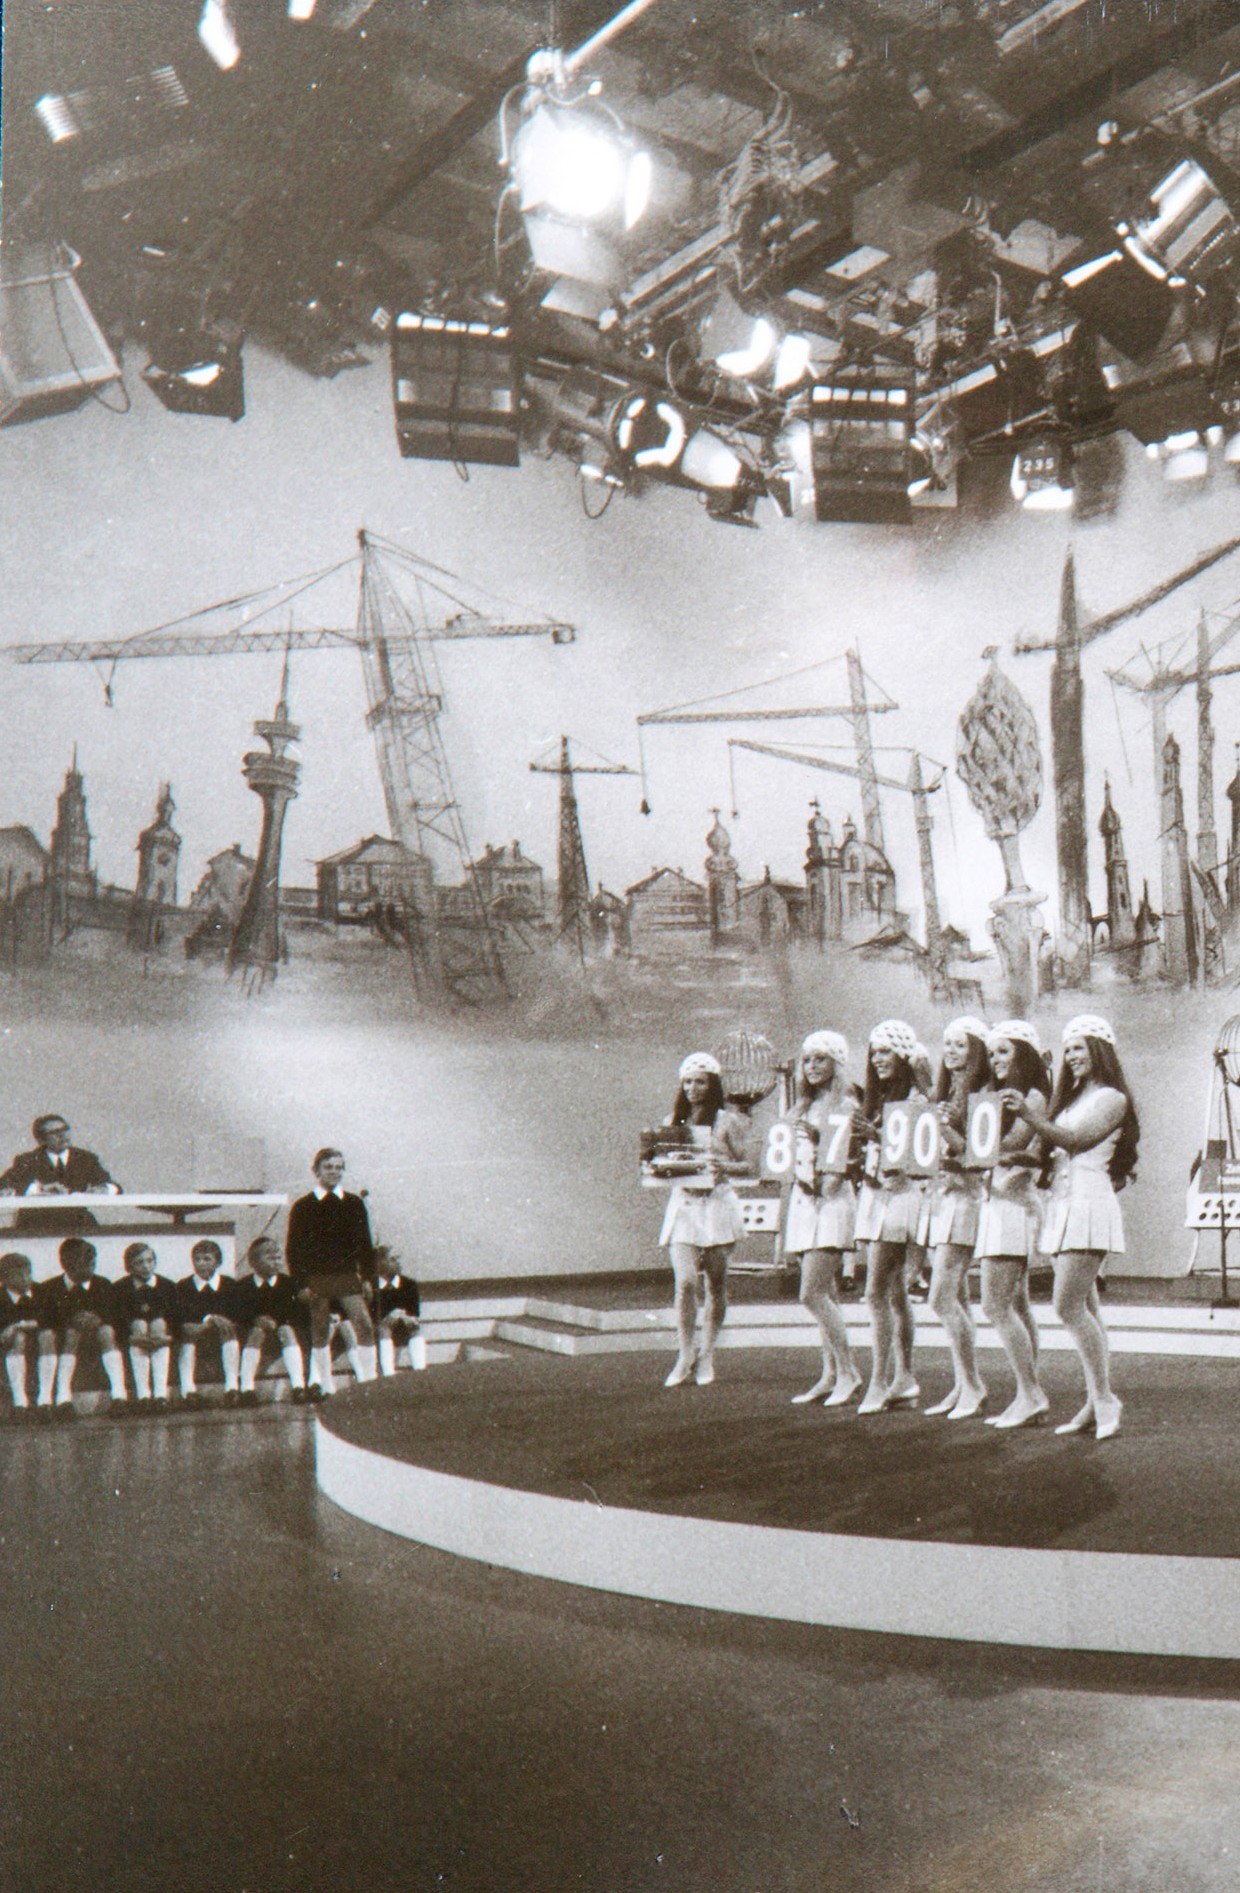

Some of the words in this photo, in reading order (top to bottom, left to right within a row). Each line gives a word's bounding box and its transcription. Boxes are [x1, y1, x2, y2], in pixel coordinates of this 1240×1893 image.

[1023, 457, 1054, 472] 235
[765, 1123, 793, 1174] 8
[825, 1113, 850, 1164] 7
[970, 1101, 998, 1159] 0
